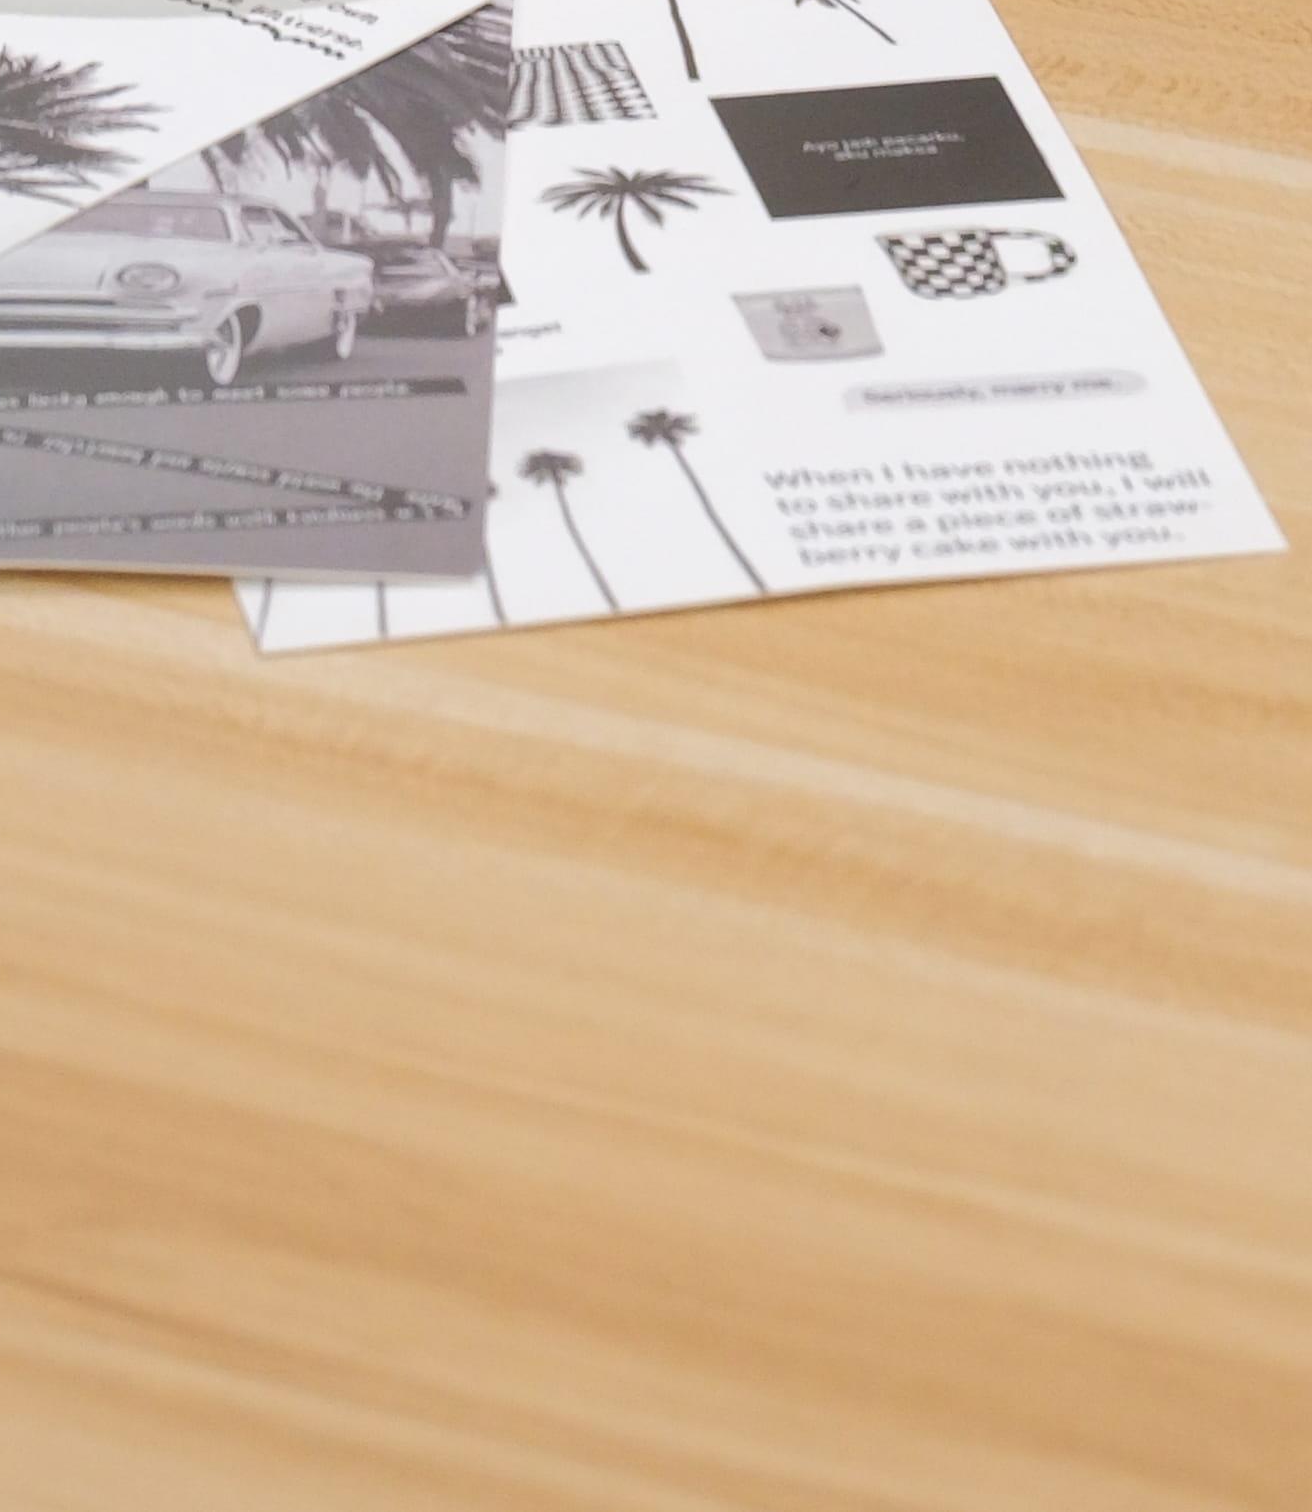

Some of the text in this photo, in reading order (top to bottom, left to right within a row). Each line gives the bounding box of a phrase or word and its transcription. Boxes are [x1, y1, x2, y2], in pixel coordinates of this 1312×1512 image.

[762, 449, 1155, 491] When I have nothing
[775, 496, 819, 516] to
[826, 489, 932, 512] share
[940, 483, 1025, 506] with
[1120, 474, 1134, 494] I
[1142, 467, 1213, 490] will
[789, 519, 894, 542] share
[904, 517, 928, 535] a
[935, 508, 1037, 535] piece
[1045, 501, 1084, 525] of
[796, 543, 901, 568] berry
[911, 536, 1000, 559] cake
[1007, 529, 1094, 551] with
